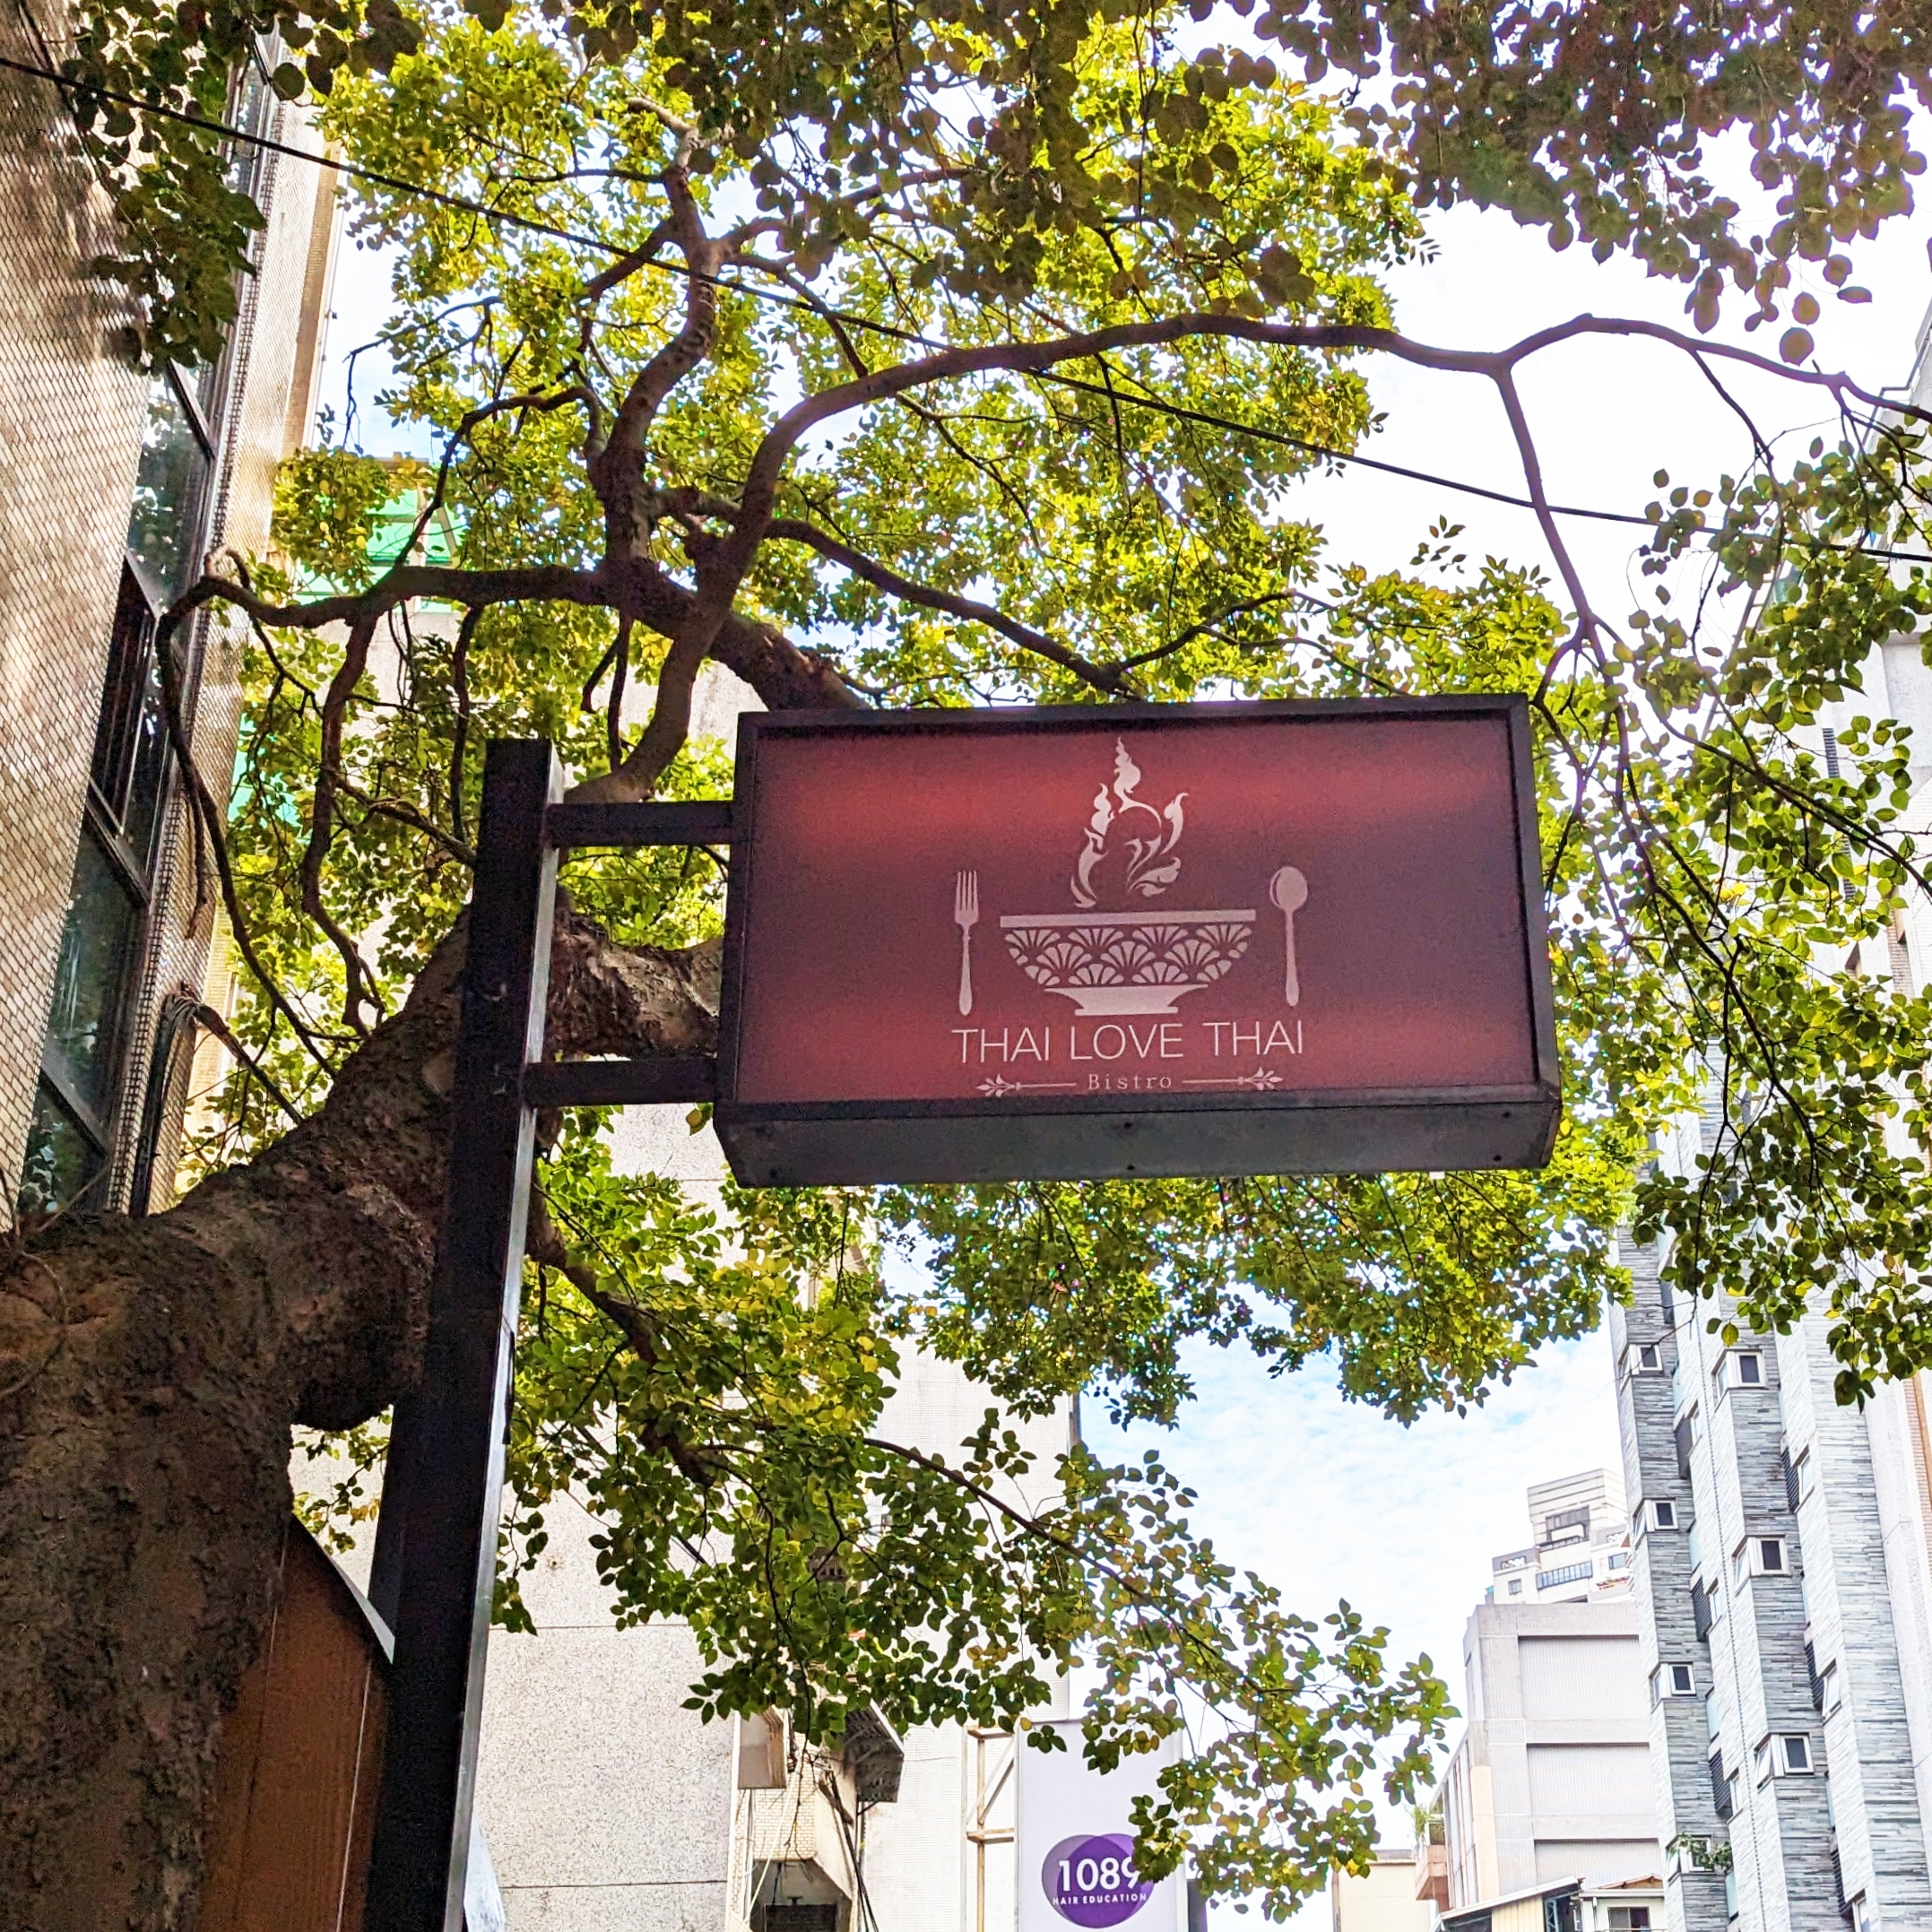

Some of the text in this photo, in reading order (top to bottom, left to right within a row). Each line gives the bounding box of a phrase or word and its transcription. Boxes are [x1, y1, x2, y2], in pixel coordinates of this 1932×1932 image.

[951, 1019, 1303, 1063] THAI LOVE THAI
[1087, 1072, 1173, 1091] Bistro
[1059, 1857, 1140, 1892] 1089
[1053, 1893, 1148, 1905] HAIR EDUCATION
